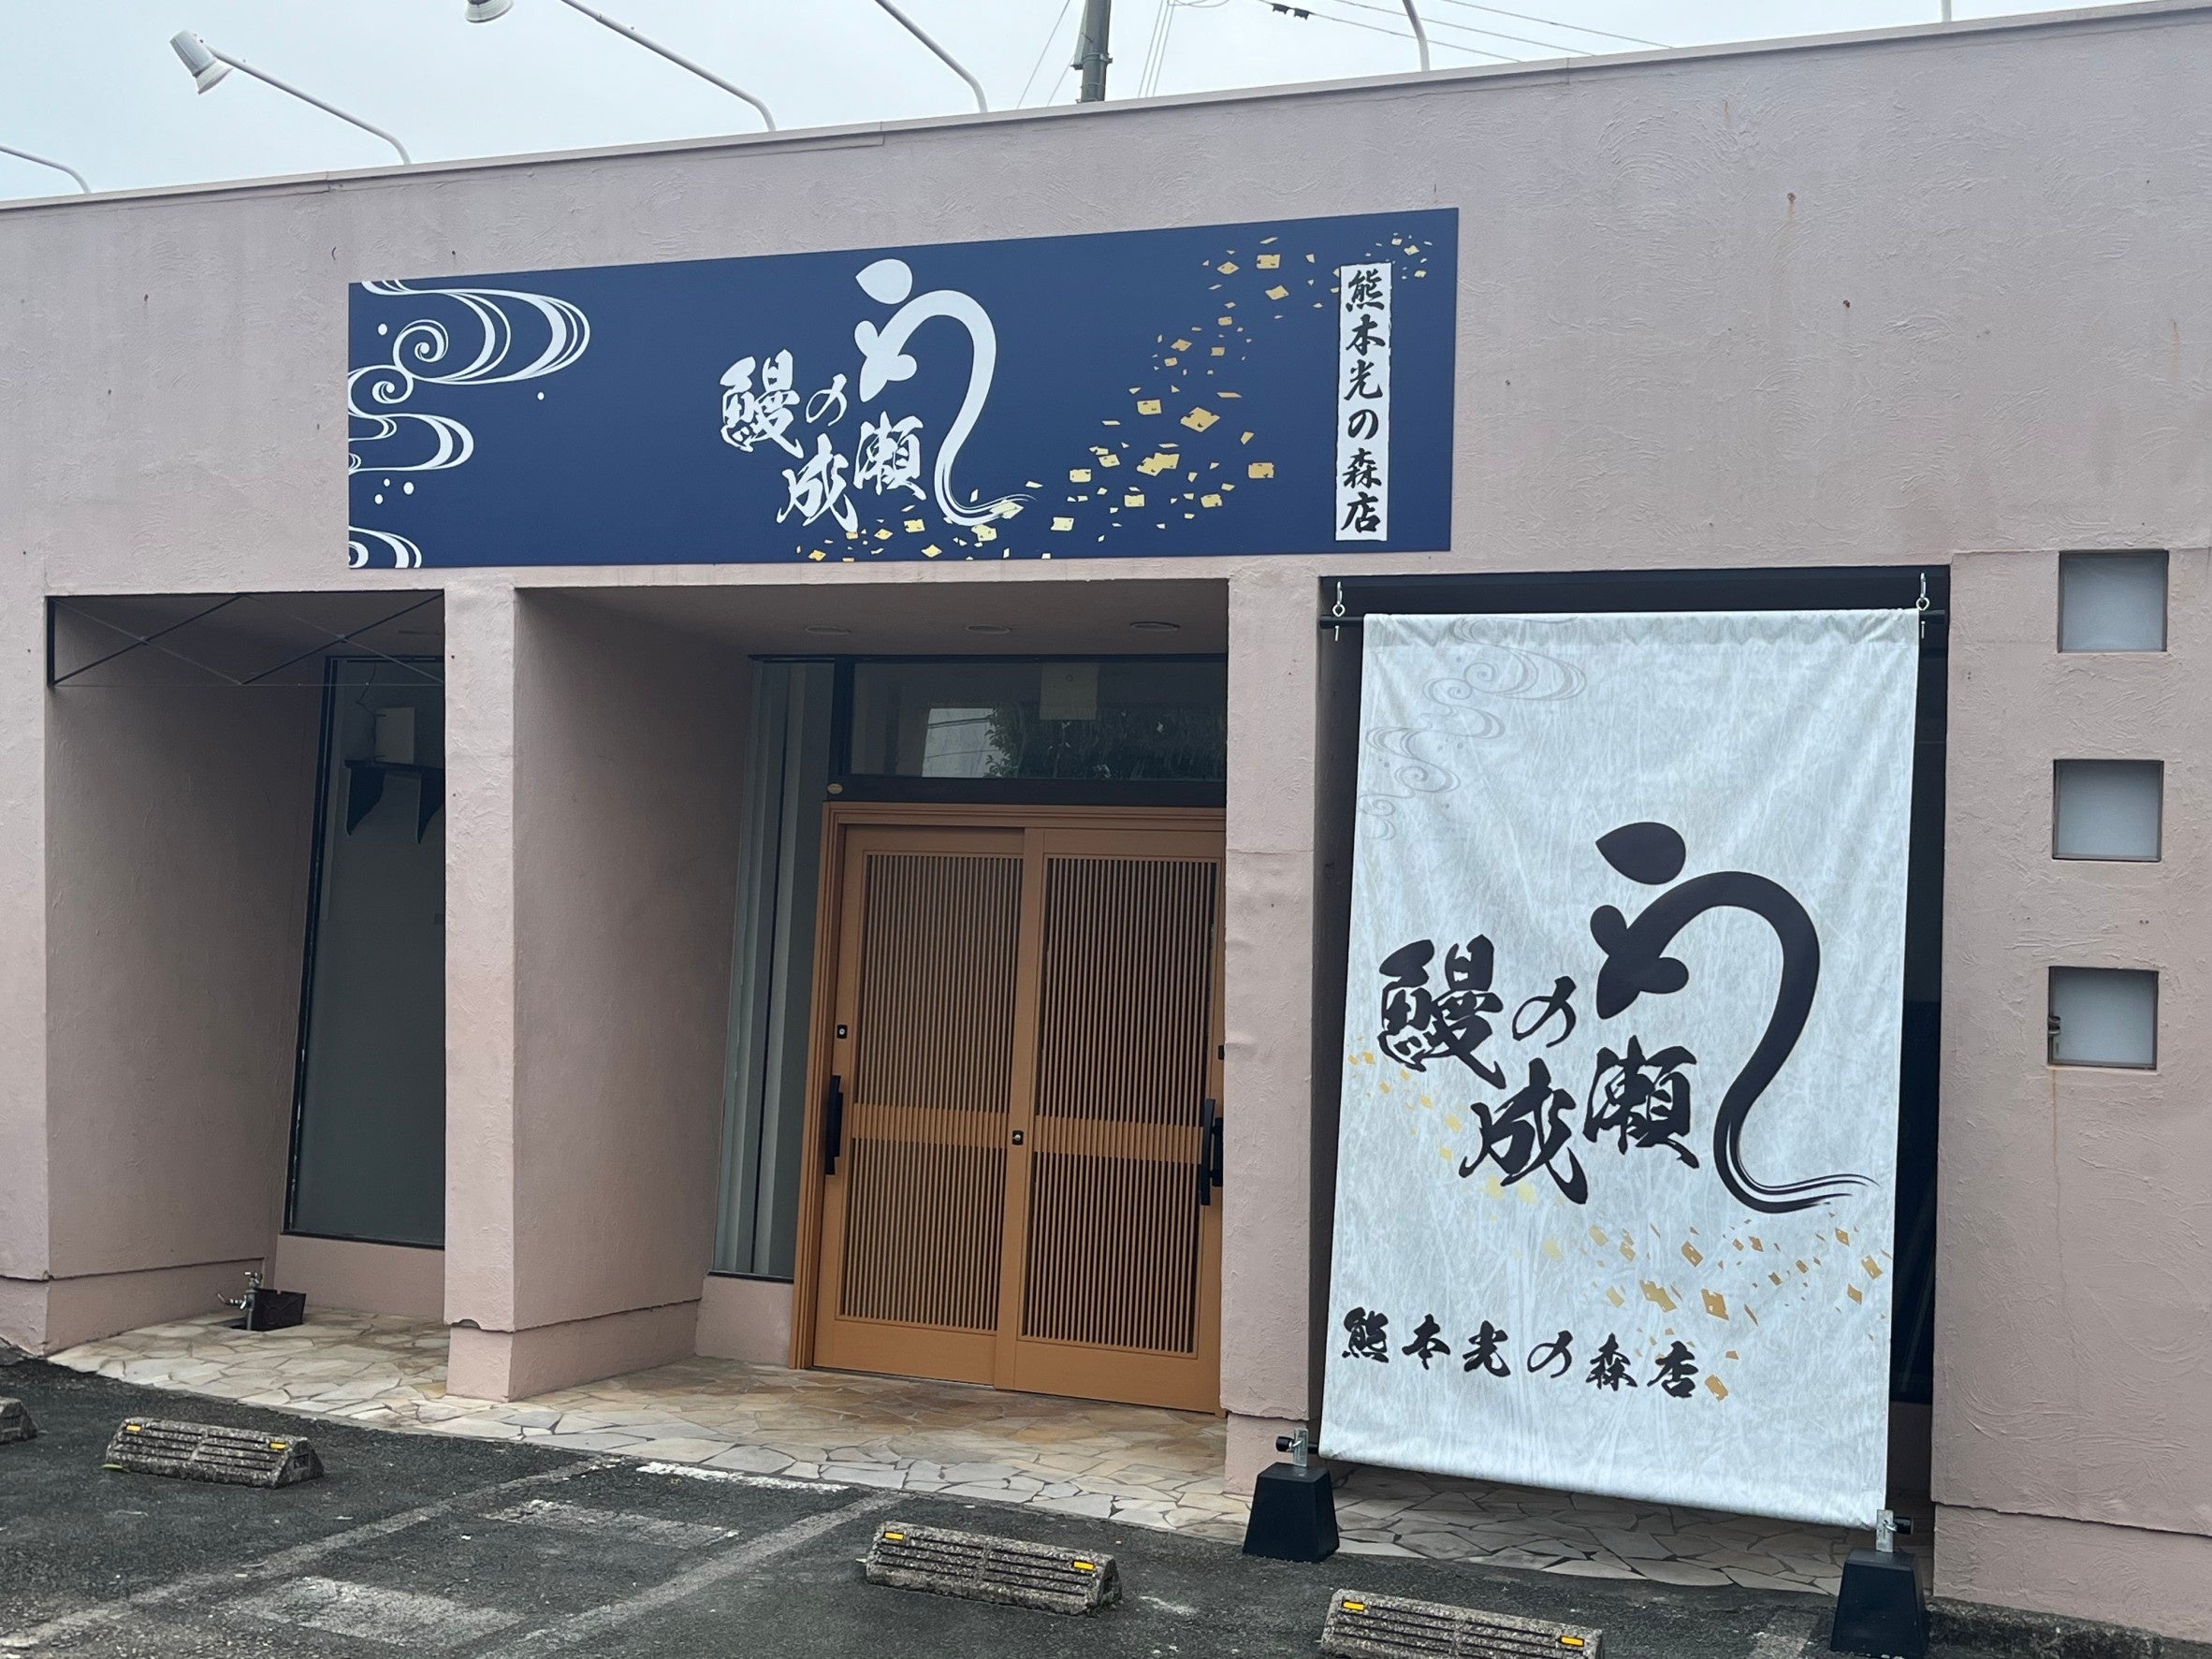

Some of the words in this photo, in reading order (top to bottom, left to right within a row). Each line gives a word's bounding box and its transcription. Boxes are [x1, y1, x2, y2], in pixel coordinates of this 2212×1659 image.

[1340, 268, 1387, 533] 熊本光の森店
[1341, 1306, 1699, 1399] 熊本光の森店
